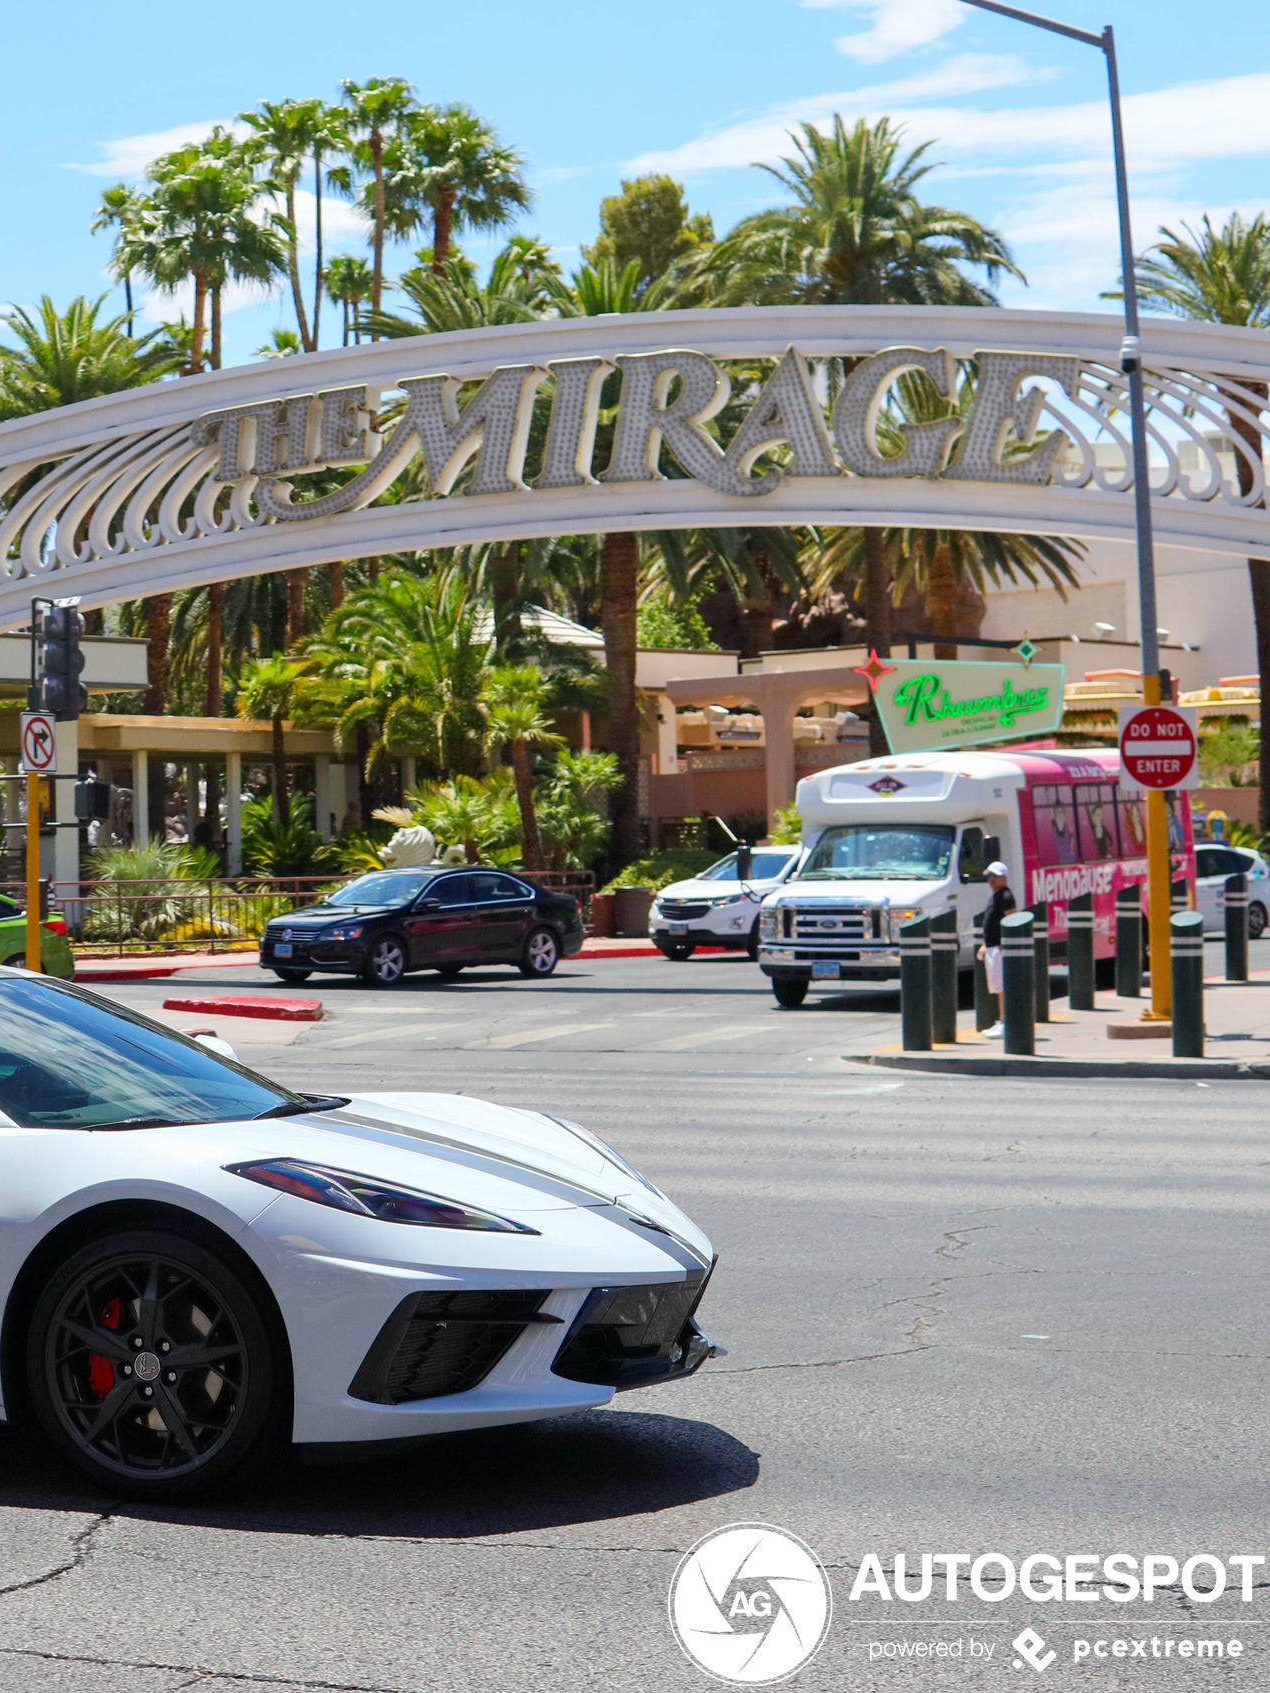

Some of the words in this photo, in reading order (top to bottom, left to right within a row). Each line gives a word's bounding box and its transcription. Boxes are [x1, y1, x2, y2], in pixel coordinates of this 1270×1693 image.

[189, 384, 371, 482] THE
[254, 343, 1080, 521] MIRAGE
[894, 674, 1049, 727] Rhumbar
[967, 723, 997, 735] LOUNGE
[1130, 723, 1151, 737] DO
[1157, 723, 1185, 737] NOT
[1136, 760, 1181, 773] ENTER
[1032, 864, 1113, 905] Menopause
